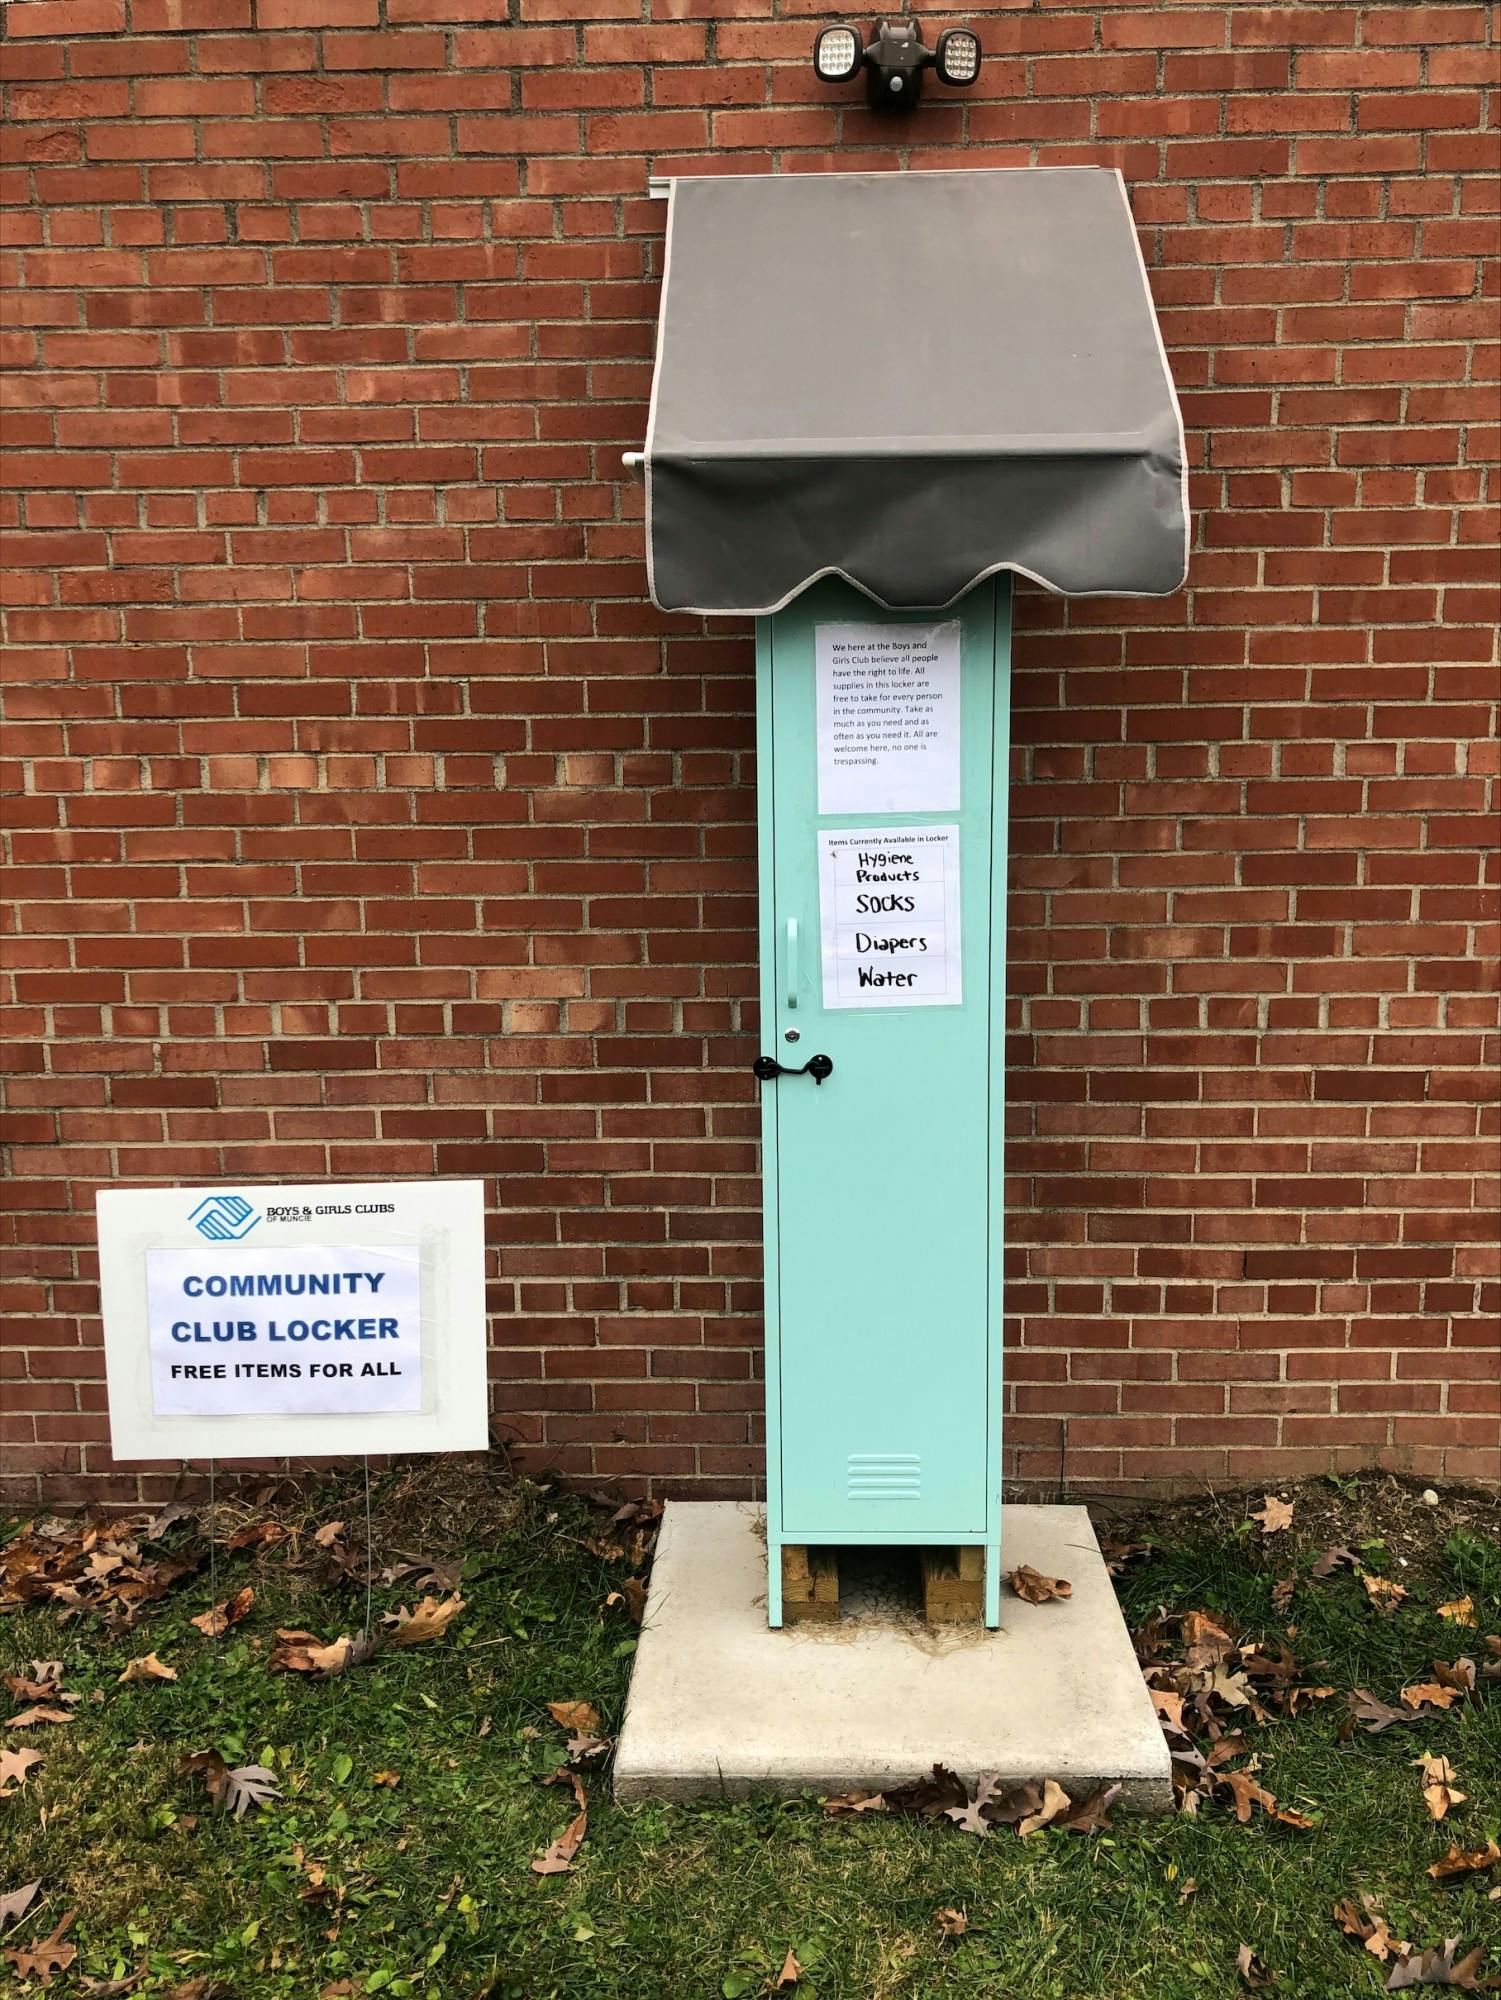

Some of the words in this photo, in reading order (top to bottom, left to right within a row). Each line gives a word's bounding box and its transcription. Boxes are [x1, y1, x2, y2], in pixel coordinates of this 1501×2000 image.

[832, 644, 846, 652] We
[867, 643, 876, 651] at
[877, 642, 890, 650] the
[892, 642, 910, 651] Boys
[852, 656, 869, 664] Club
[871, 655, 899, 663] believe
[912, 654, 939, 663] people
[868, 669, 886, 678] right
[915, 667, 925, 675] All
[833, 682, 864, 690] supplies
[891, 680, 915, 688] locker
[833, 695, 848, 703] free
[861, 694, 877, 702] take
[879, 693, 890, 701] for
[893, 694, 914, 702] every
[916, 693, 943, 701] person
[834, 707, 841, 715] in
[857, 706, 903, 715] community.
[905, 705, 923, 713] Take
[866, 720, 881, 728] you
[883, 718, 903, 726] need
[833, 732, 854, 740] often
[866, 732, 881, 741] you
[883, 731, 902, 739] need
[870, 744, 890, 753] here,
[834, 757, 879, 767] trespassing.
[849, 838, 882, 846] Currently
[883, 836, 916, 844] Available
[858, 851, 914, 868] Hygiene
[856, 869, 920, 883] Products
[856, 933, 927, 954] Diapers
[858, 966, 917, 987] Water
[267, 1207, 300, 1217] BOYS
[302, 1206, 313, 1216] &
[315, 1204, 352, 1215] GIRLS
[355, 1203, 395, 1213] CLUBS
[183, 1272, 385, 1297] COMMUNITY
[171, 1320, 257, 1343] CLUB
[268, 1318, 399, 1341] LOCKER
[171, 1364, 226, 1379] FREE
[235, 1363, 302, 1378] ITEMS
[309, 1363, 353, 1378] FOR
[361, 1361, 402, 1376] ALL
